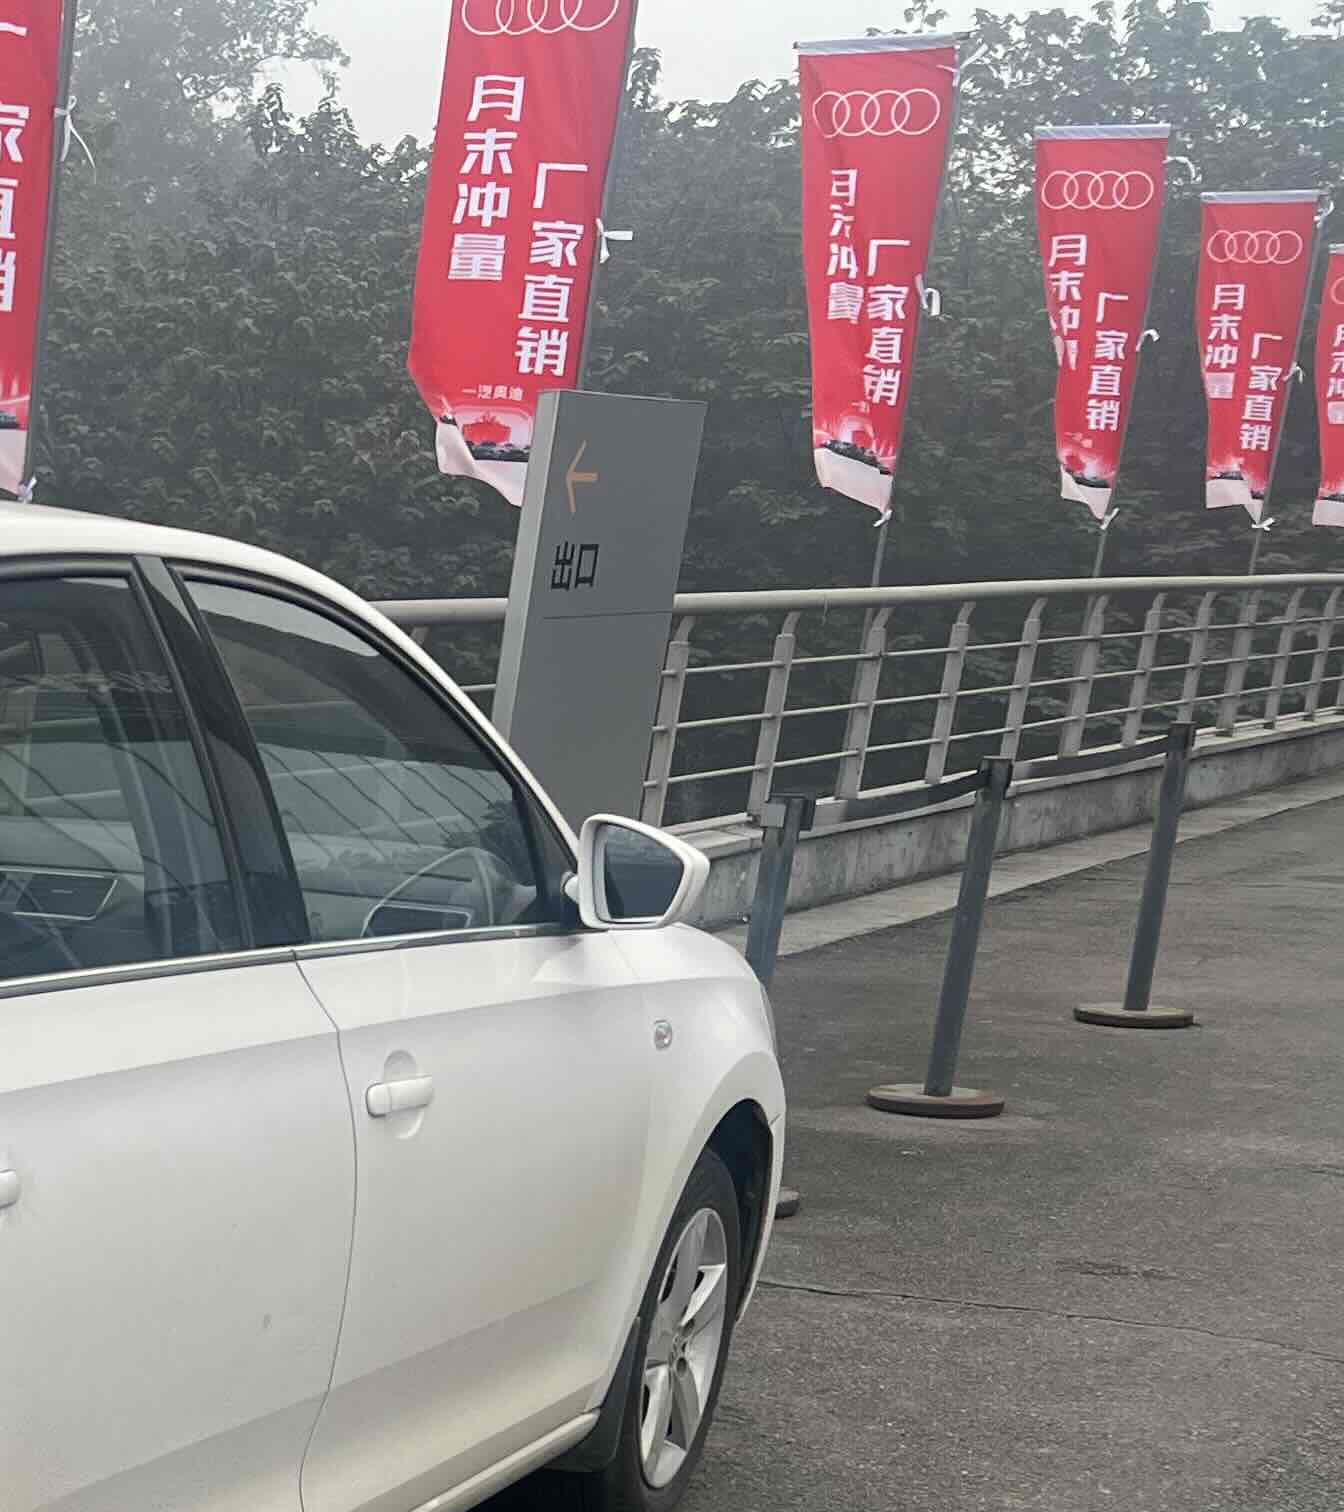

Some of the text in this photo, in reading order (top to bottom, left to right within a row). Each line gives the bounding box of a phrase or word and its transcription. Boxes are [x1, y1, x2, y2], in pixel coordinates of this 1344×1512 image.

[448, 74, 525, 281] 月末冲量
[514, 162, 588, 377] 厂家直销
[863, 239, 911, 406] 厂家直销
[1085, 291, 1129, 431] 厂家直销
[1240, 332, 1283, 452] 厂家直销
[550, 540, 600, 591] 出口
